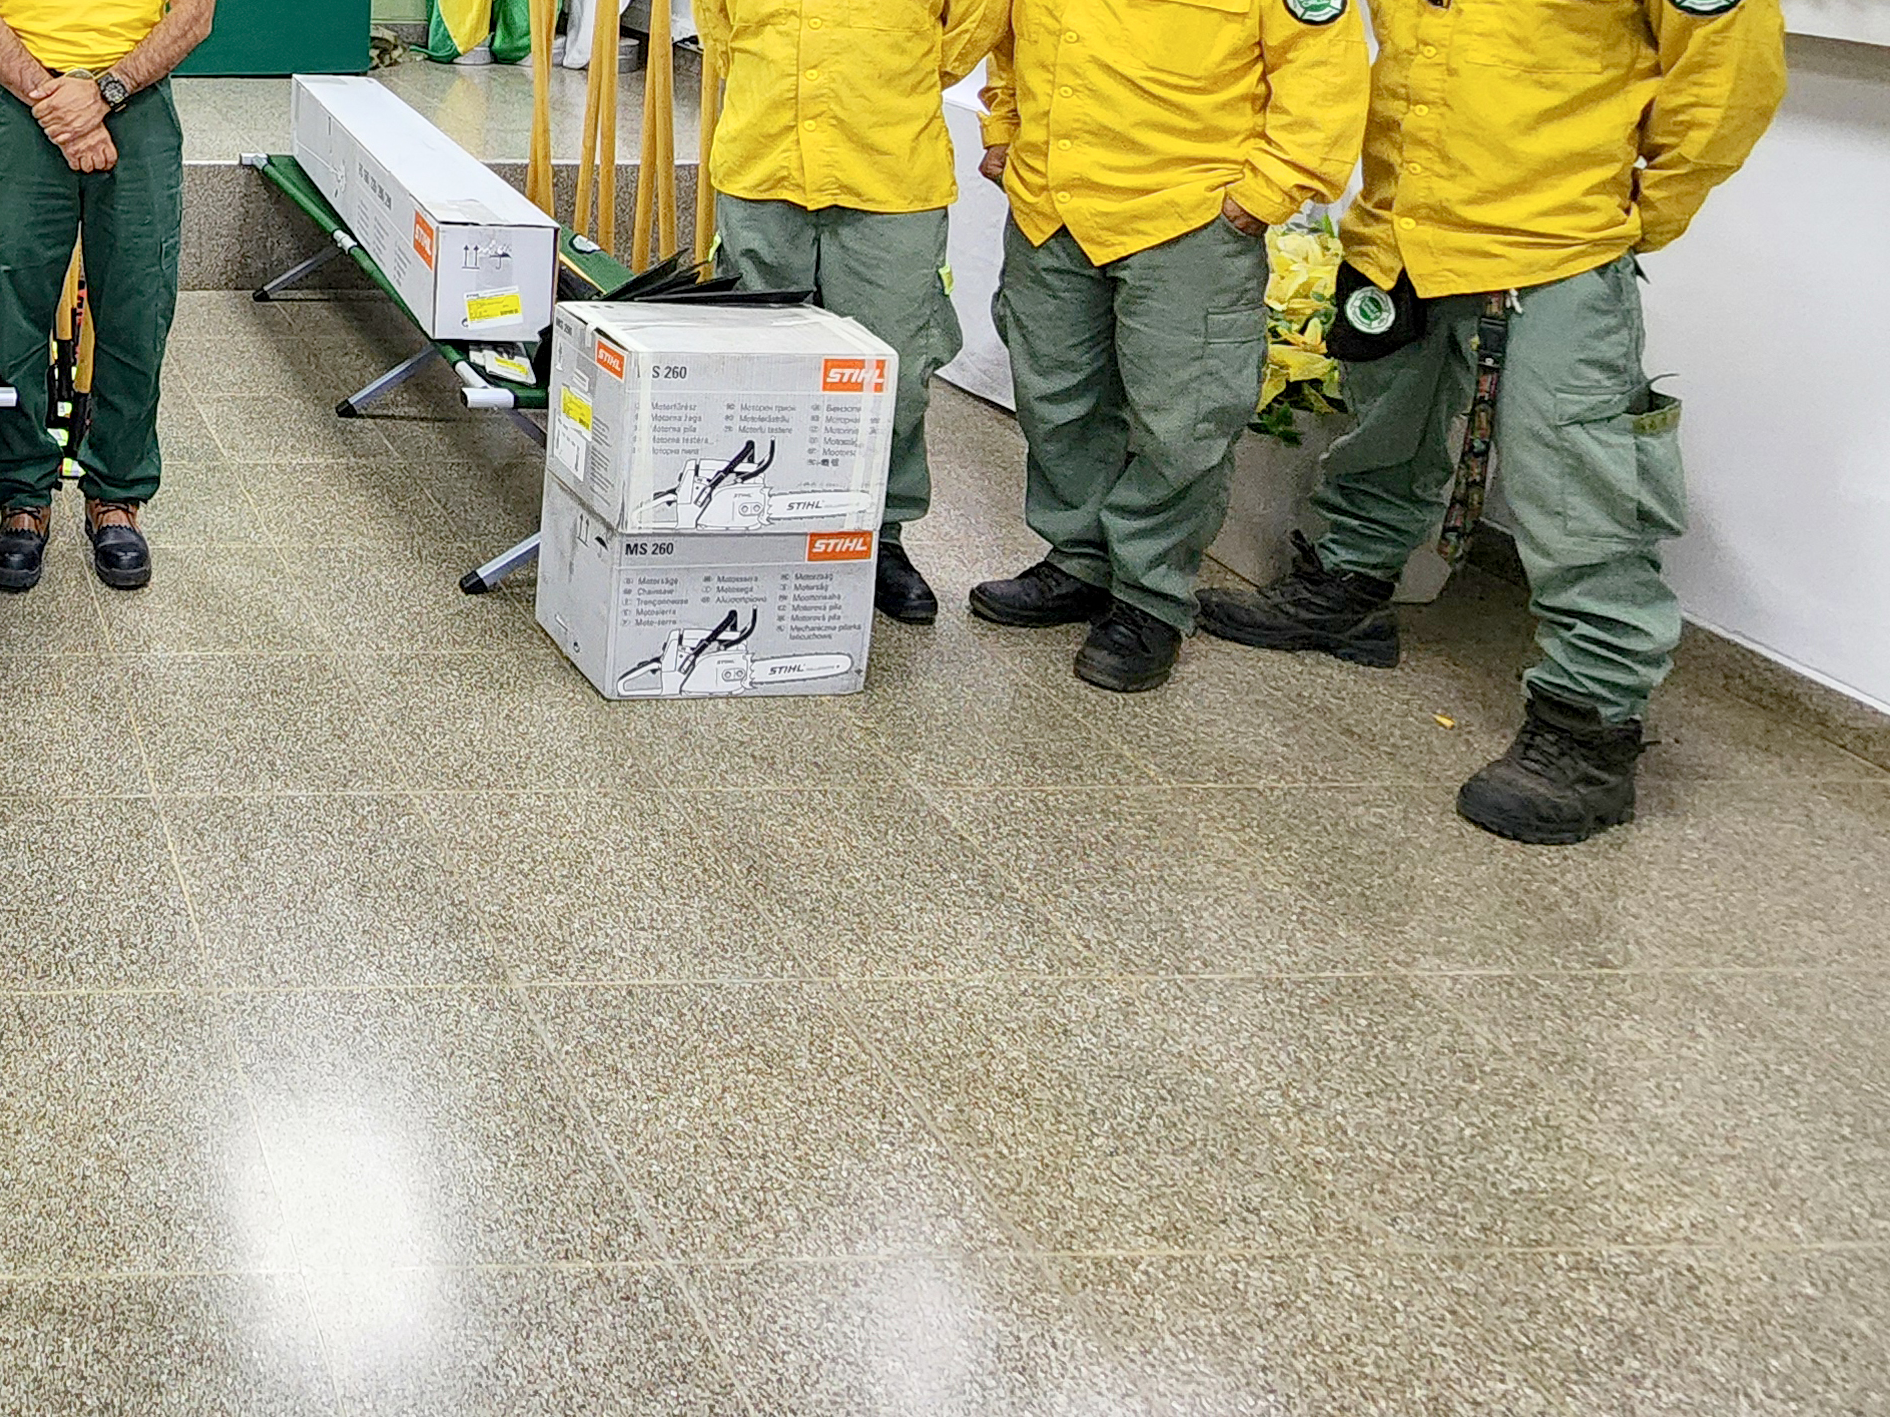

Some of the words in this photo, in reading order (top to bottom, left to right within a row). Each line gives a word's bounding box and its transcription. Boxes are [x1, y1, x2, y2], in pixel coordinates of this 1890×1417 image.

[597, 348, 621, 372] STIHL
[664, 366, 687, 379] 260
[826, 368, 884, 384] STIHL
[786, 501, 823, 510] STIHL
[625, 543, 648, 556] MS
[651, 543, 674, 555] 260
[812, 537, 868, 552] STIHL
[769, 664, 805, 675] STIHL
